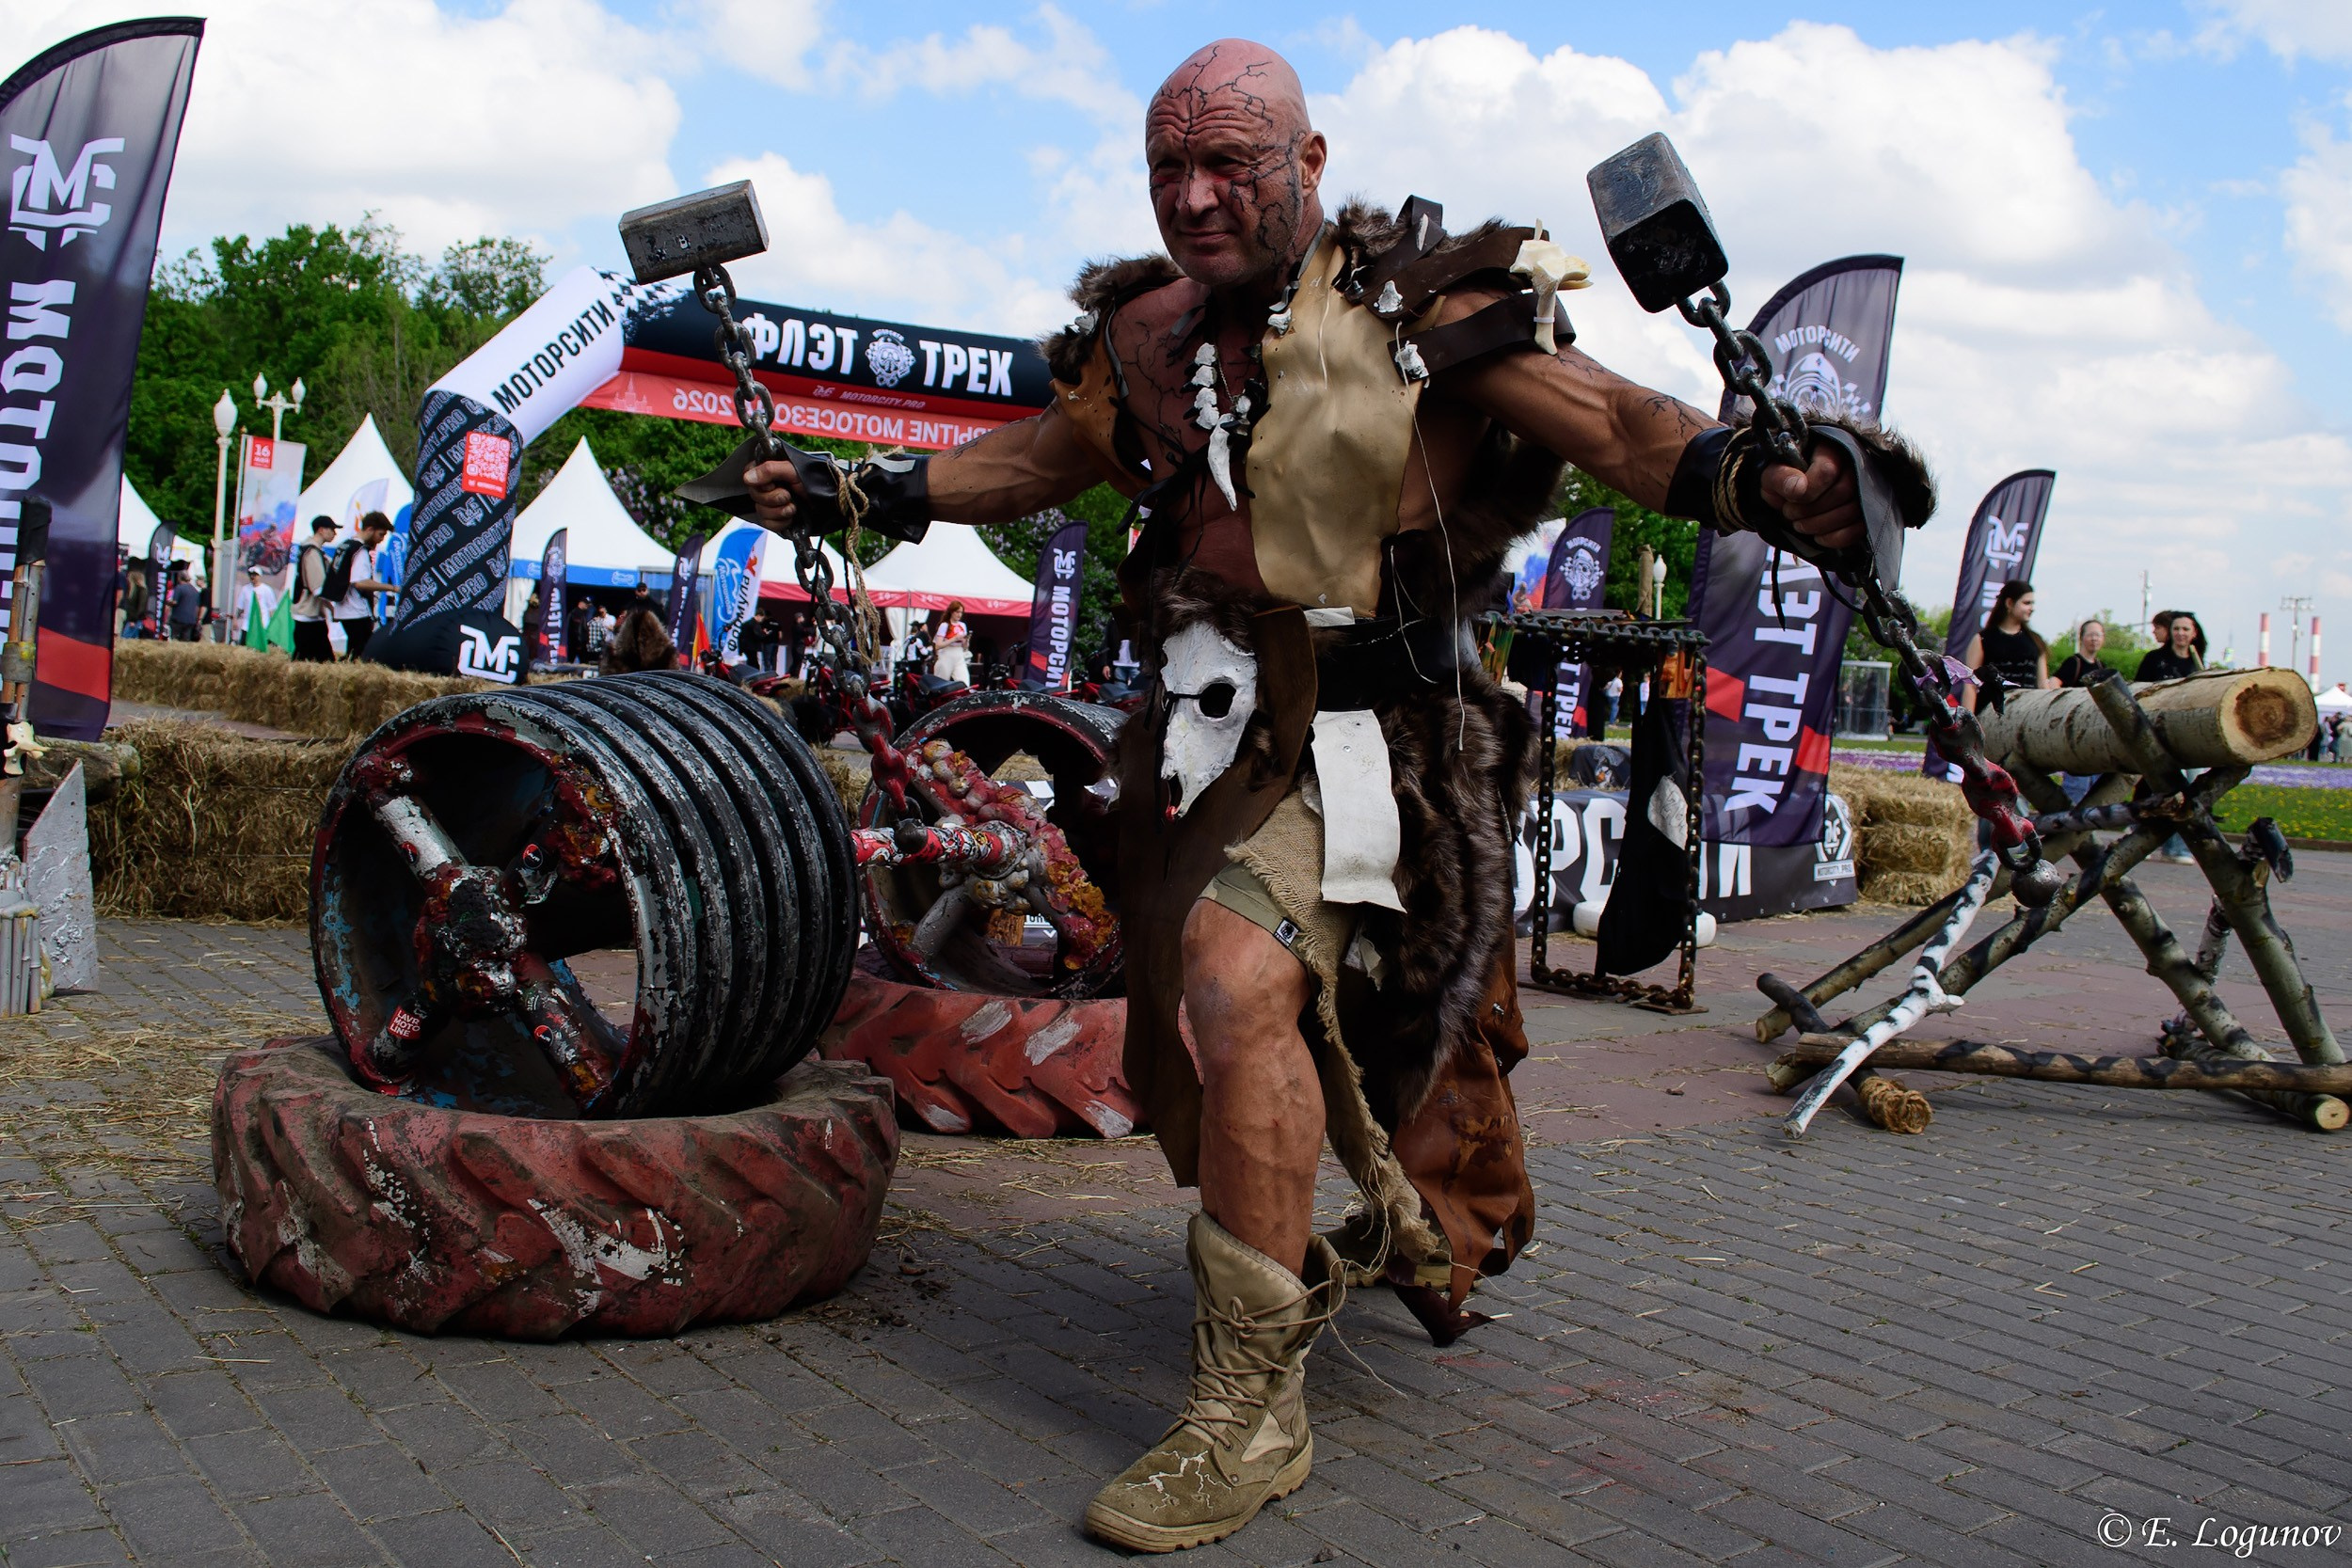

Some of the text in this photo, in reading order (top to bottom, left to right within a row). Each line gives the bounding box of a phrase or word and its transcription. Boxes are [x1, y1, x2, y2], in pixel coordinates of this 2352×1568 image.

[491, 299, 616, 415] МОТОРСИТИ
[741, 312, 1014, 396] ФЛЭТ ТРЕК
[1774, 325, 1861, 363] МОТОРСИТИ
[254, 443, 271, 457] 16
[1045, 585, 1071, 688] МОТОРСИТ
[1724, 672, 1810, 815] ТРЕК
[389, 1022, 411, 1037] LINE
[393, 1017, 421, 1032] MOTO
[397, 1009, 420, 1025] LAVR
